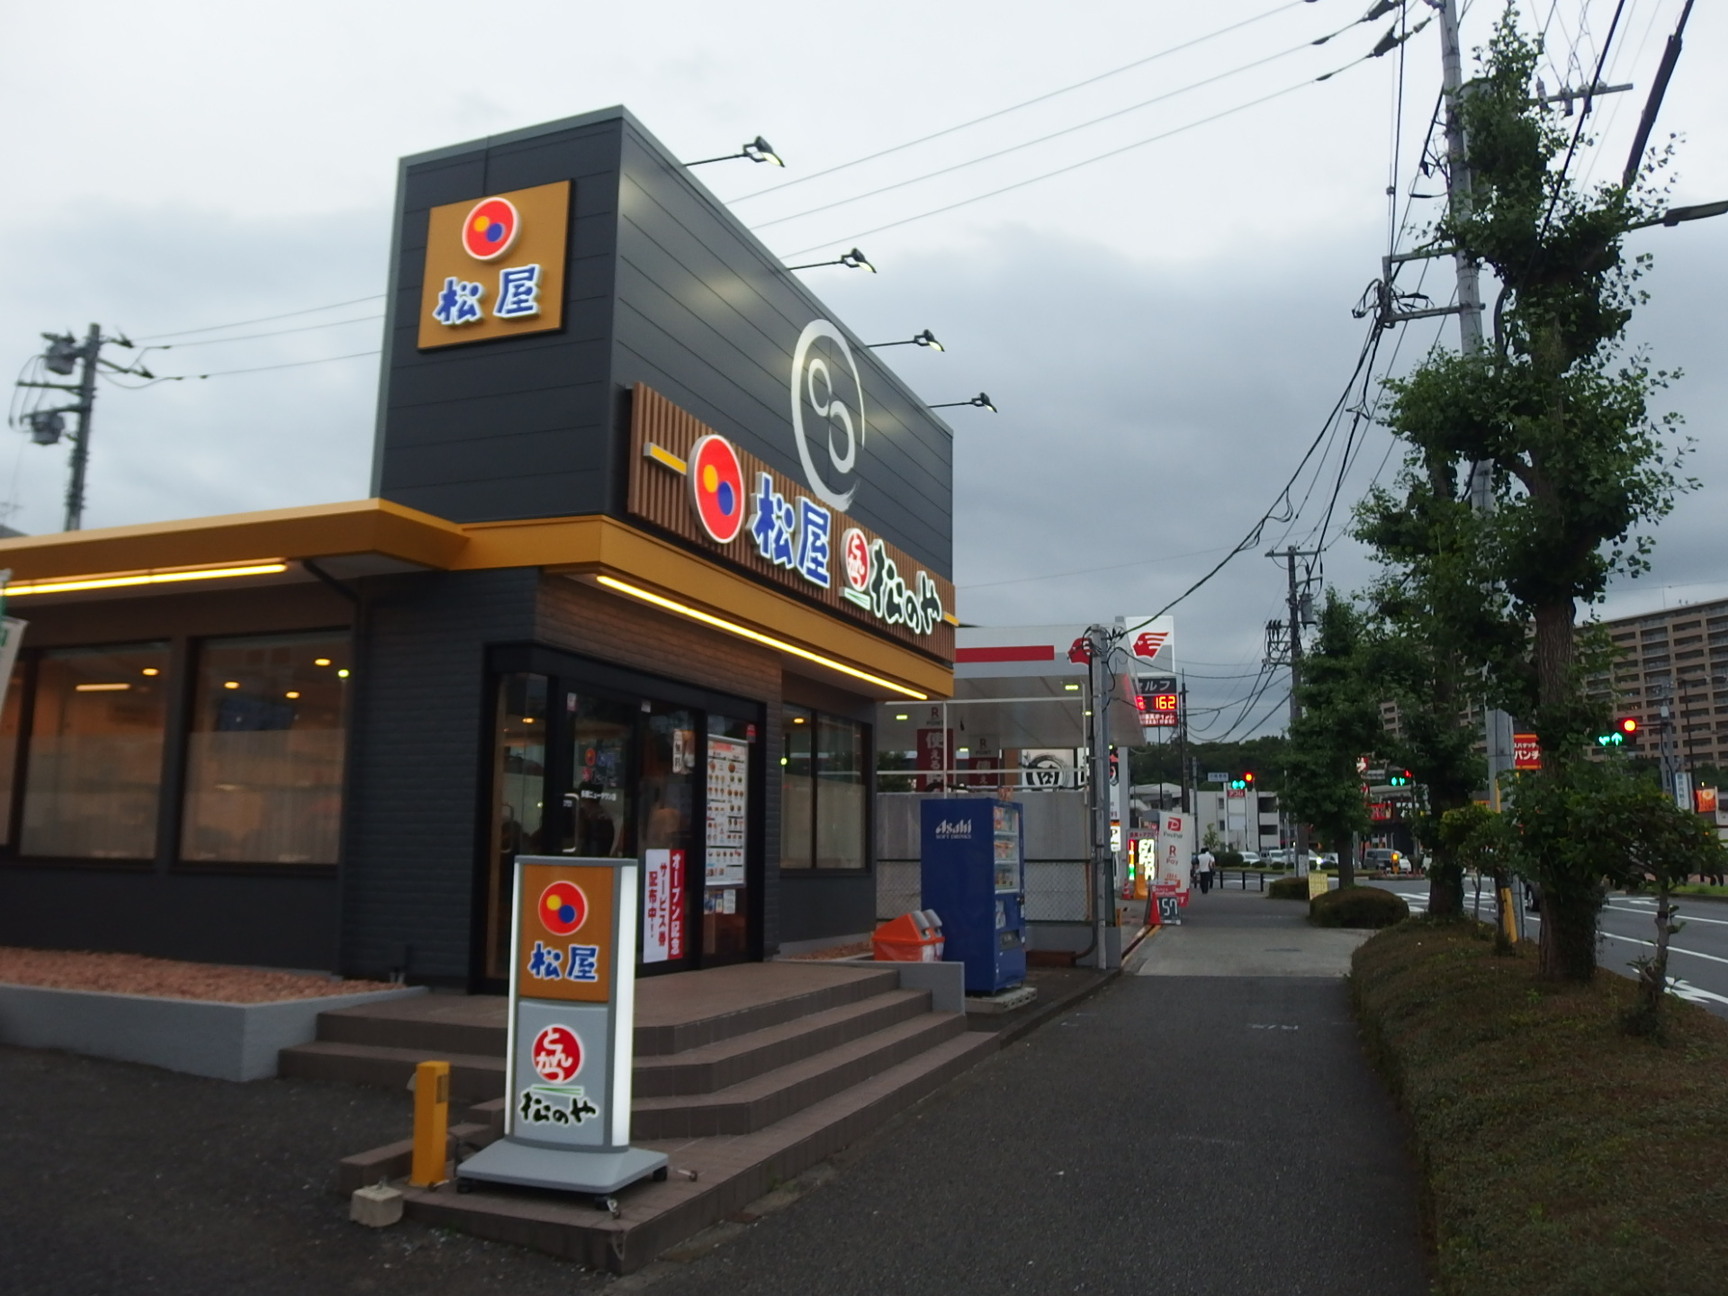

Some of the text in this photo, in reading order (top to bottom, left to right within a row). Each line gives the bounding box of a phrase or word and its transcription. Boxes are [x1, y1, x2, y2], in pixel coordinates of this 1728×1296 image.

[432, 264, 539, 325] 松屋
[752, 471, 831, 588] 松屋
[1154, 695, 1176, 710] 162
[935, 818, 972, 834] Asahi
[1169, 845, 1177, 856] R
[658, 863, 668, 947] サービス券
[671, 853, 681, 955] オープン記念
[528, 941, 599, 982] 松屋
[535, 1027, 574, 1081] とんかつ
